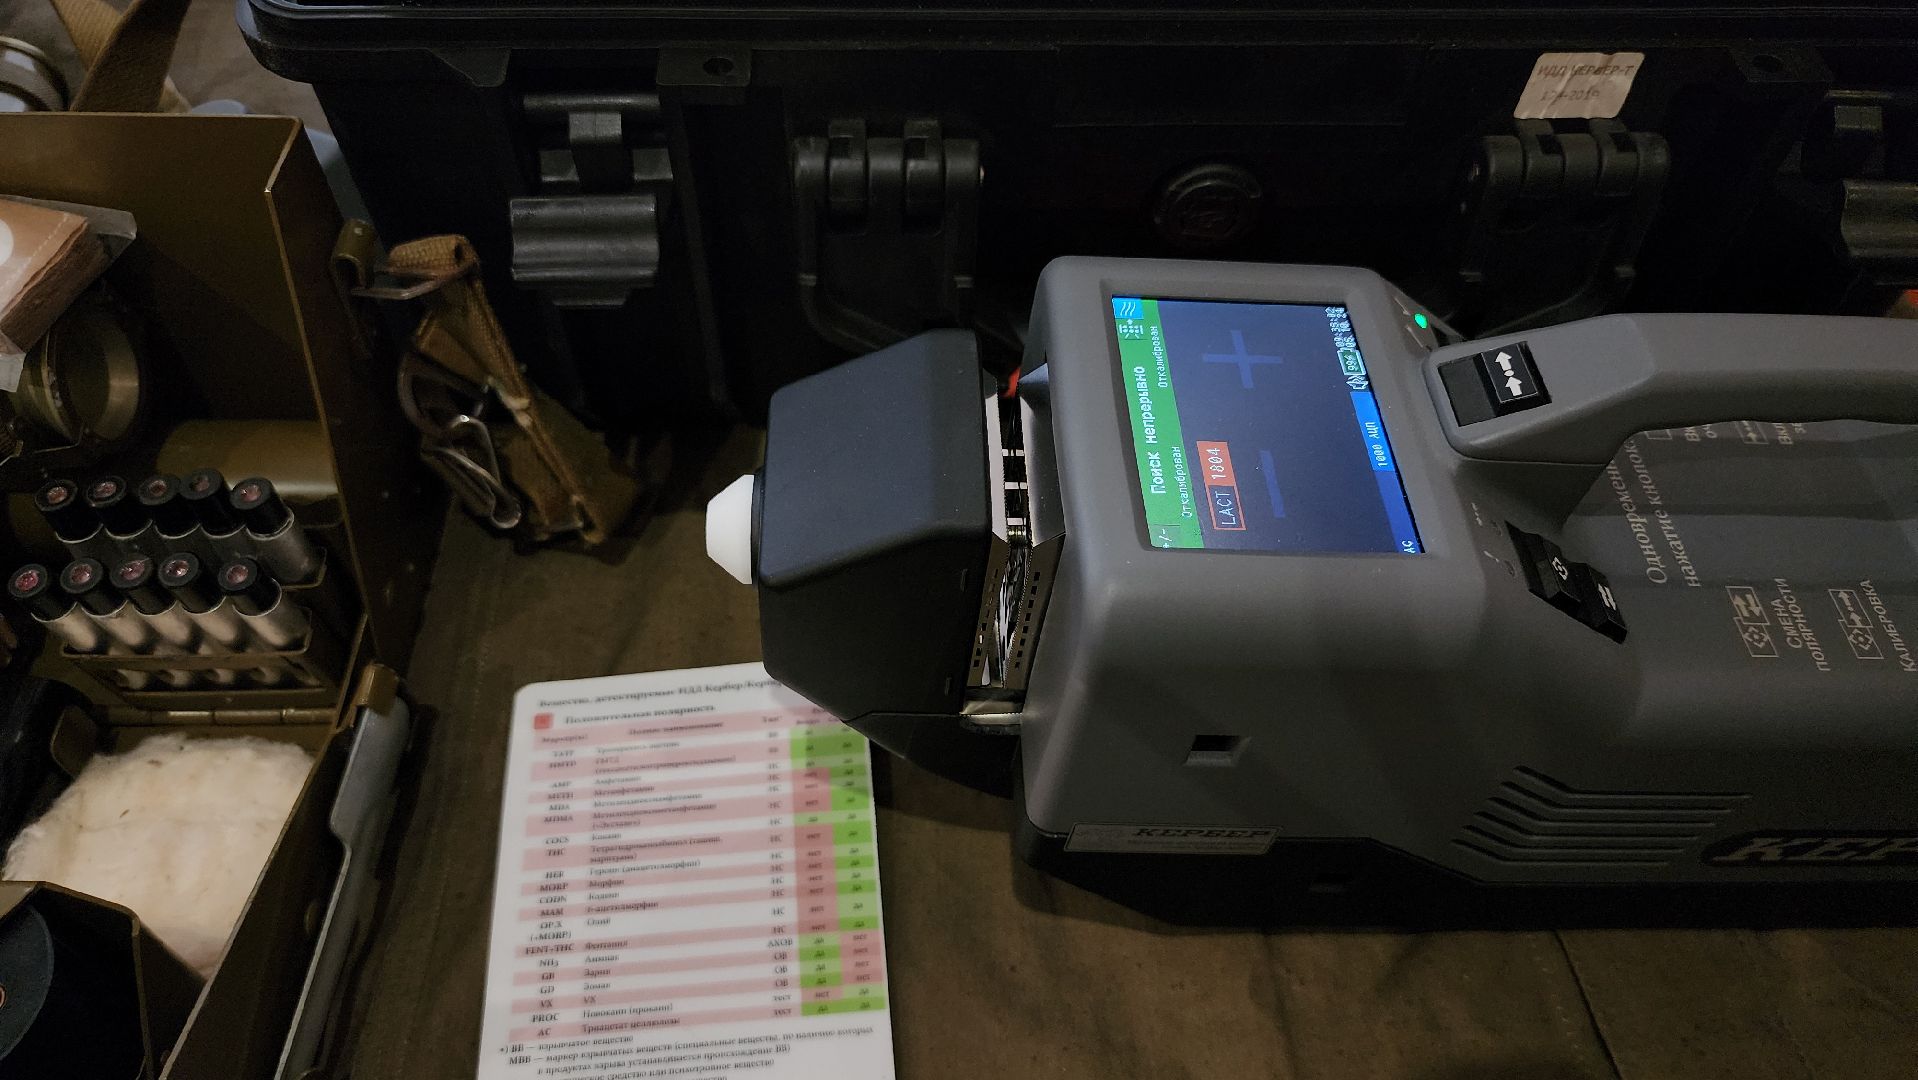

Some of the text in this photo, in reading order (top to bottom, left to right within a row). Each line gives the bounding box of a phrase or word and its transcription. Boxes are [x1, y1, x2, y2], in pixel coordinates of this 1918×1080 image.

[1150, 326, 1168, 388] Откалиброван
[1133, 366, 1167, 494] Поиск непрерывно
[1205, 447, 1227, 480] 1804
[1371, 444, 1388, 467] 1000
[1171, 446, 1192, 518] Откалиброван
[1215, 490, 1237, 526] LACT
[1655, 509, 1702, 587] нажатие
[1860, 579, 1918, 672] КАЛИБРОВКА
[1136, 828, 1271, 838] КЕРБЕР
[531, 1012, 560, 1023] PROC
[537, 1027, 552, 1037] AC
